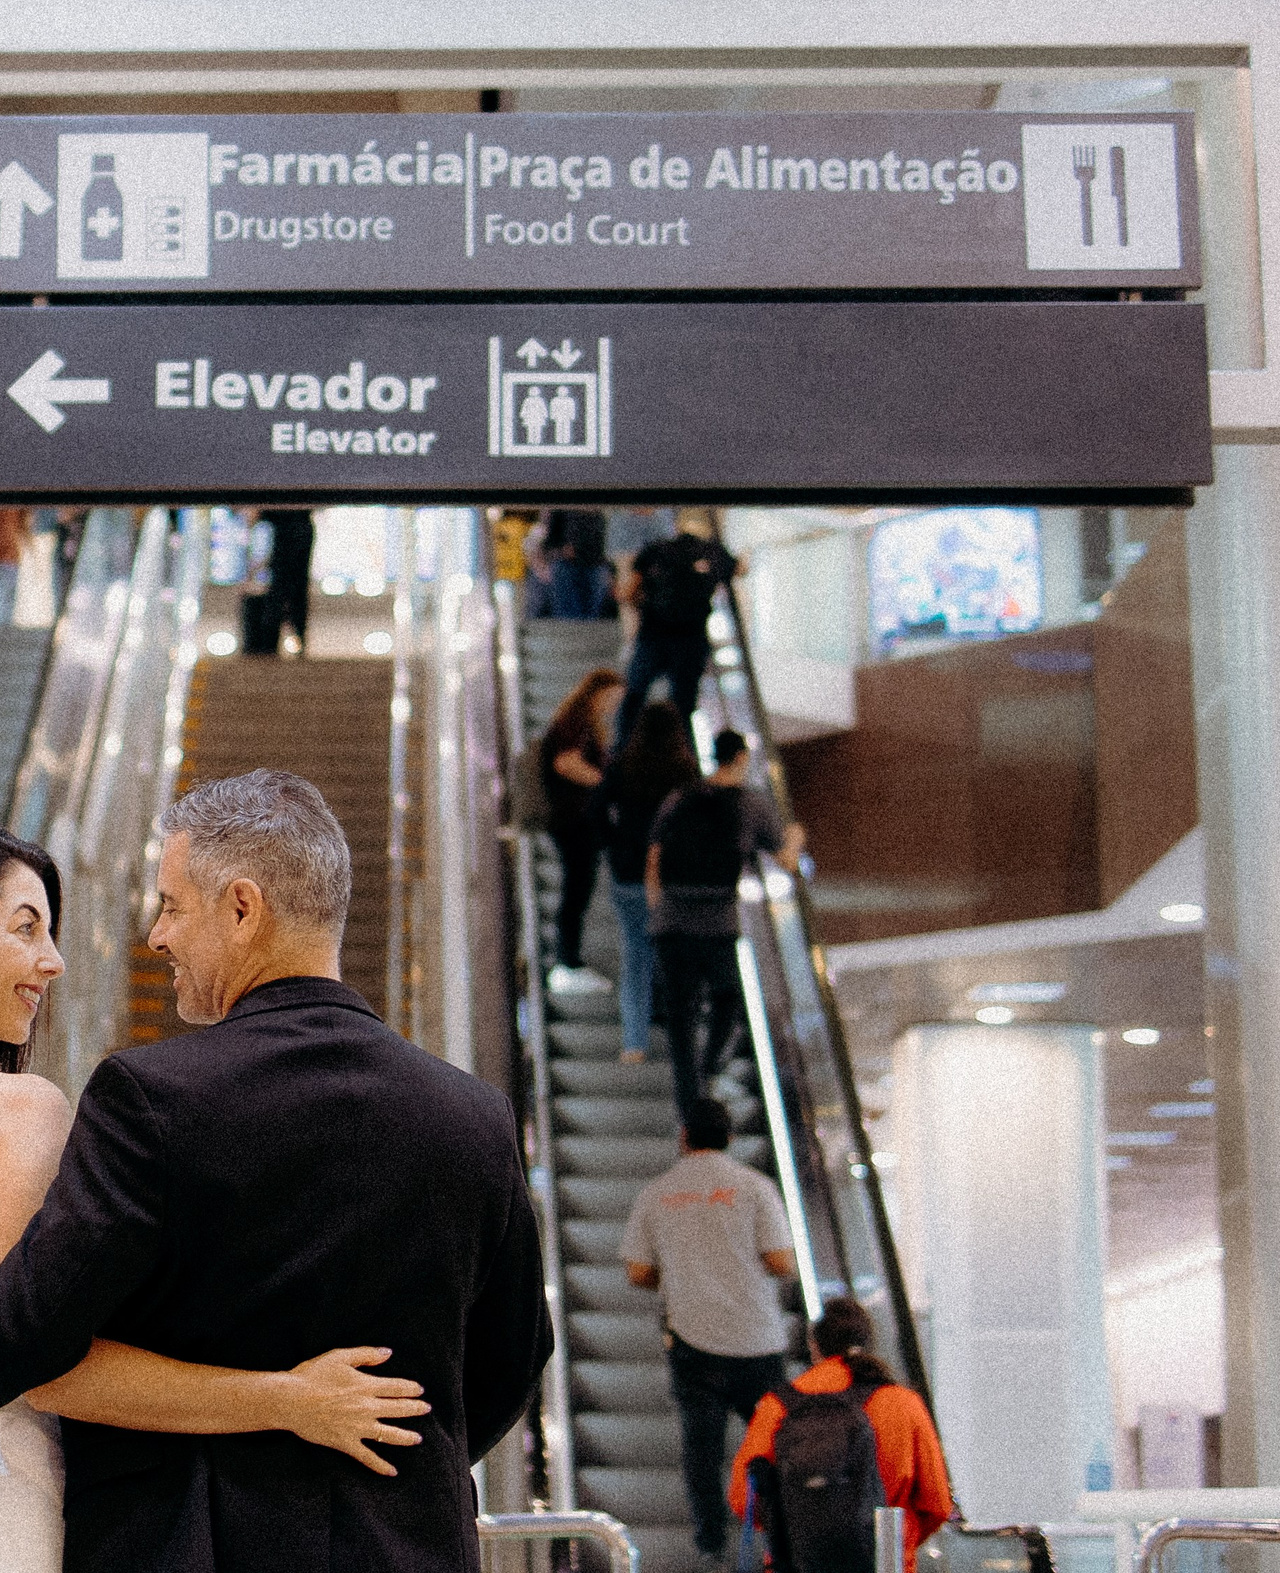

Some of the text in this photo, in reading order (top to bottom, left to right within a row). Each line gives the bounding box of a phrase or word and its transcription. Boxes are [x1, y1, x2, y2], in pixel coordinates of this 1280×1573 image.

[210, 140, 463, 186] Farmácia
[480, 144, 1019, 204] Praça de Alimentação
[214, 209, 394, 249] Drugstore
[485, 212, 691, 246] Food Court
[155, 358, 438, 412] Elevador
[271, 421, 437, 455] Elevator
